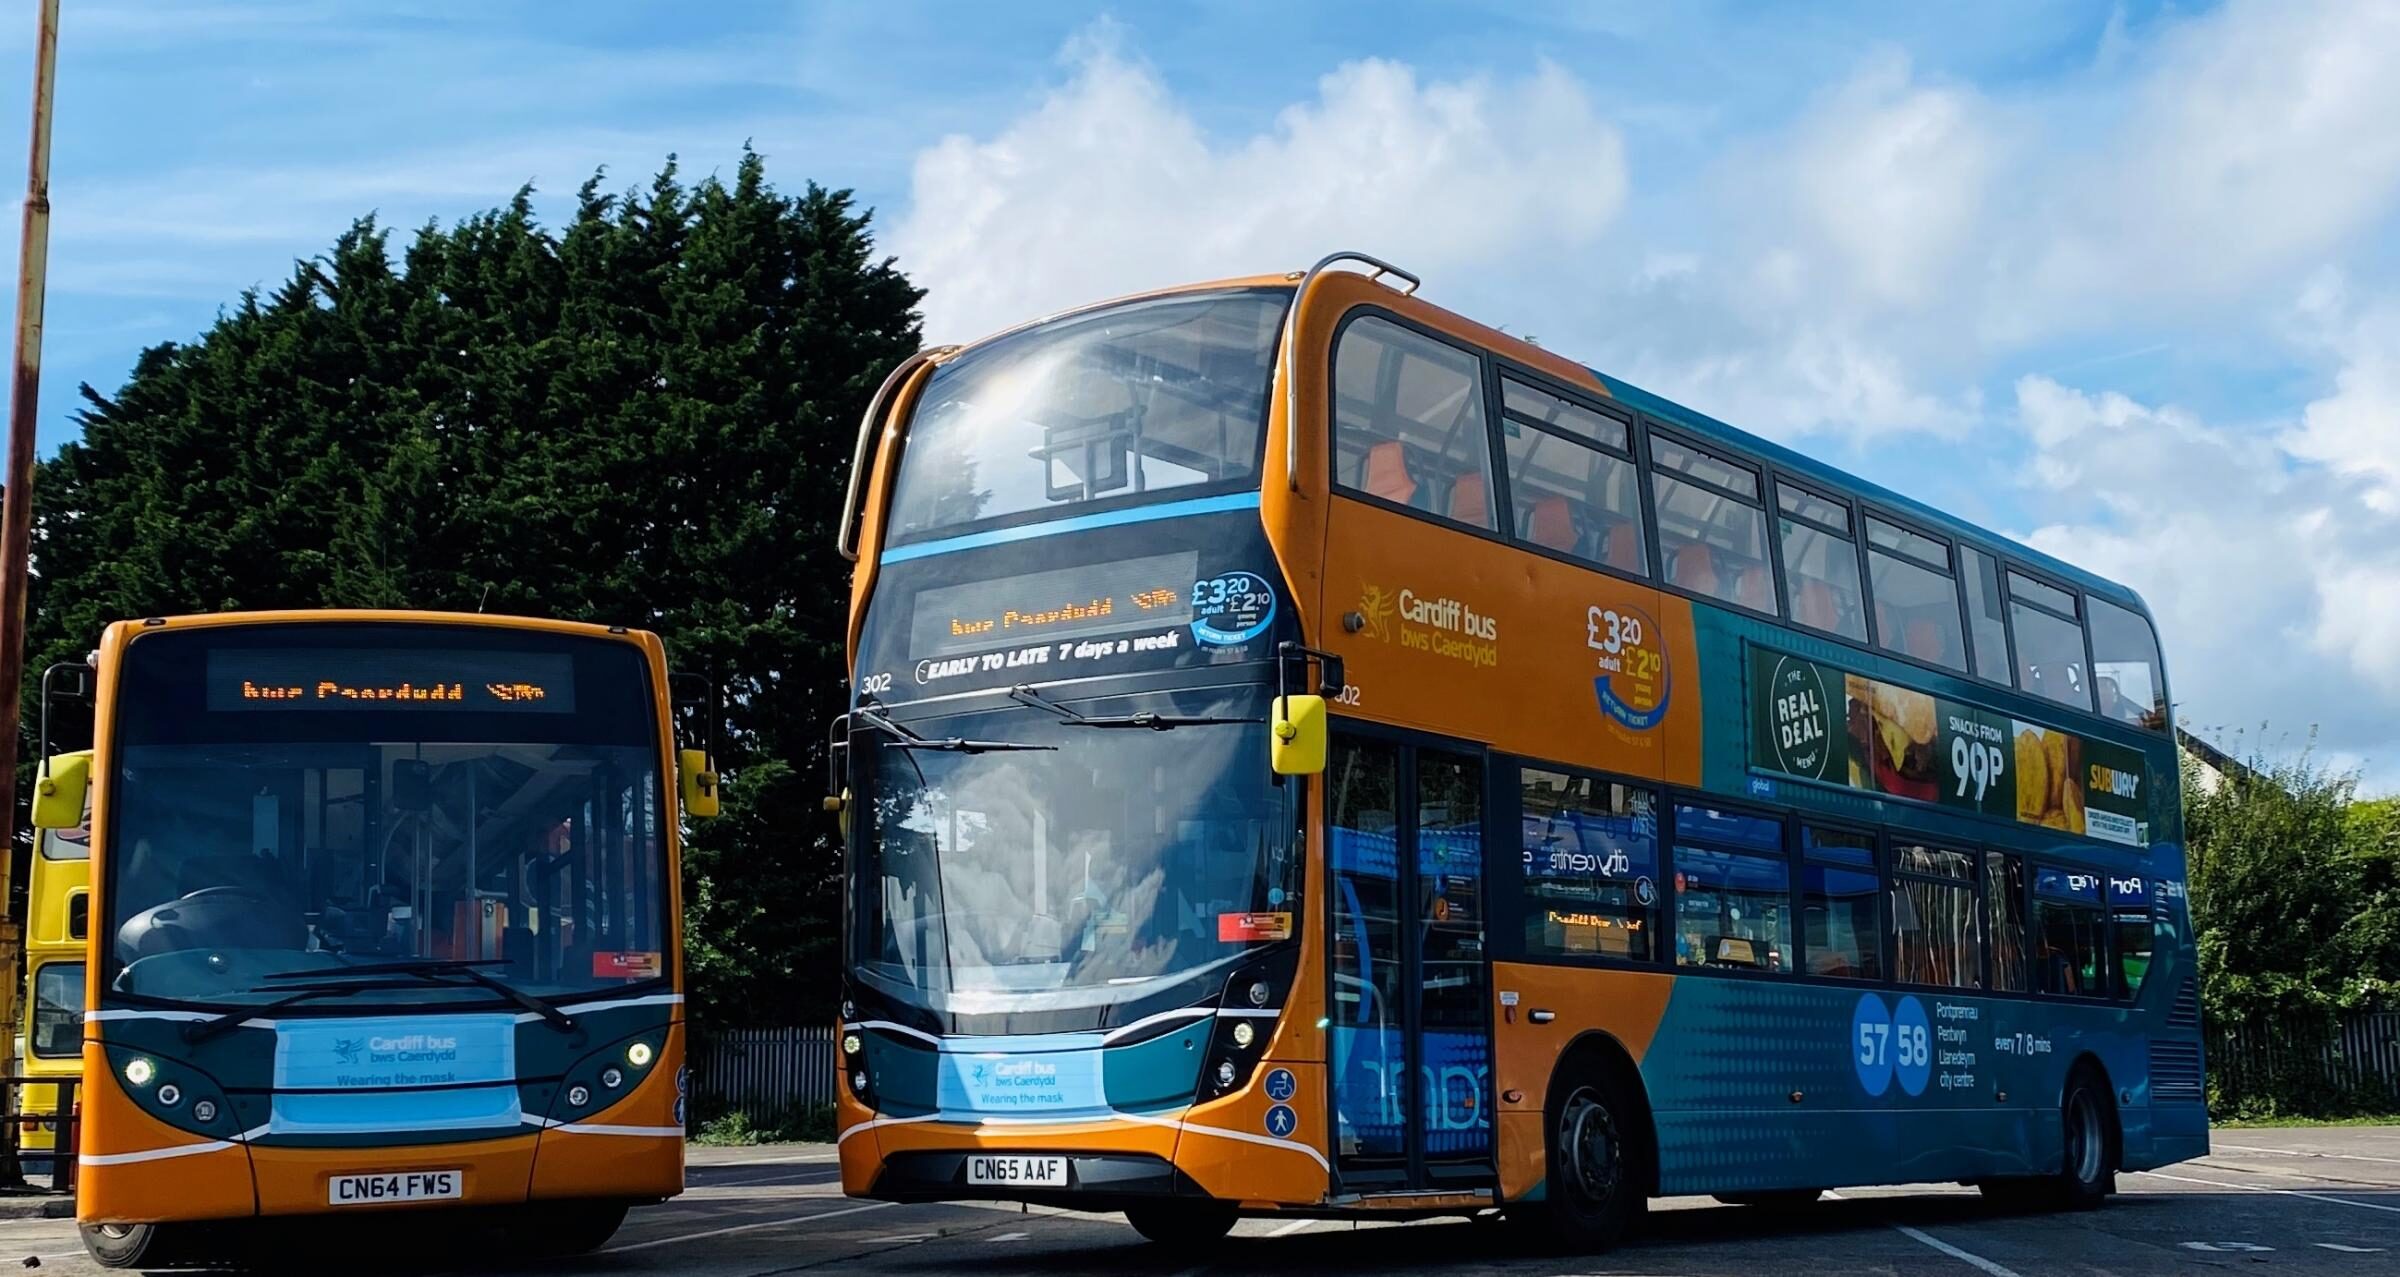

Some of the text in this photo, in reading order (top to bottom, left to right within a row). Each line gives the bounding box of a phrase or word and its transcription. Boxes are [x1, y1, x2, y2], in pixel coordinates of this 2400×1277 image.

[1201, 604, 1225, 615] adult
[1399, 588, 1497, 641] Cardiff bus
[927, 630, 1180, 680] EARLY TO LATE 7 days a week
[1400, 623, 1497, 668] bws Caerdydd
[1598, 656, 1621, 673] adult
[861, 672, 892, 694] 302
[1787, 670, 1801, 683] THE
[1777, 688, 1820, 723] REAL
[1949, 716, 2003, 744] SNACKS FROM
[1796, 751, 1816, 769] MENU
[1951, 735, 2004, 802] 99P
[1751, 779, 1770, 794] global
[2089, 764, 2139, 799] SUBWAY
[370, 1035, 456, 1051] Cardiff bus
[1860, 1023, 1928, 1067] 57 58
[1994, 1037, 2016, 1054] every
[2034, 1036, 2052, 1053] mins
[370, 1050, 456, 1064] bws Caerdydd
[996, 1060, 1056, 1075] Cardiff bus
[337, 1072, 455, 1086] Wearing the mask
[996, 1075, 1056, 1087] bws Caerdydd
[1939, 1071, 1975, 1091] city centre
[981, 1091, 1064, 1106] Wearing the mask
[974, 1158, 1058, 1180] CN65 AAF
[339, 1174, 452, 1200] CN64 FWS
